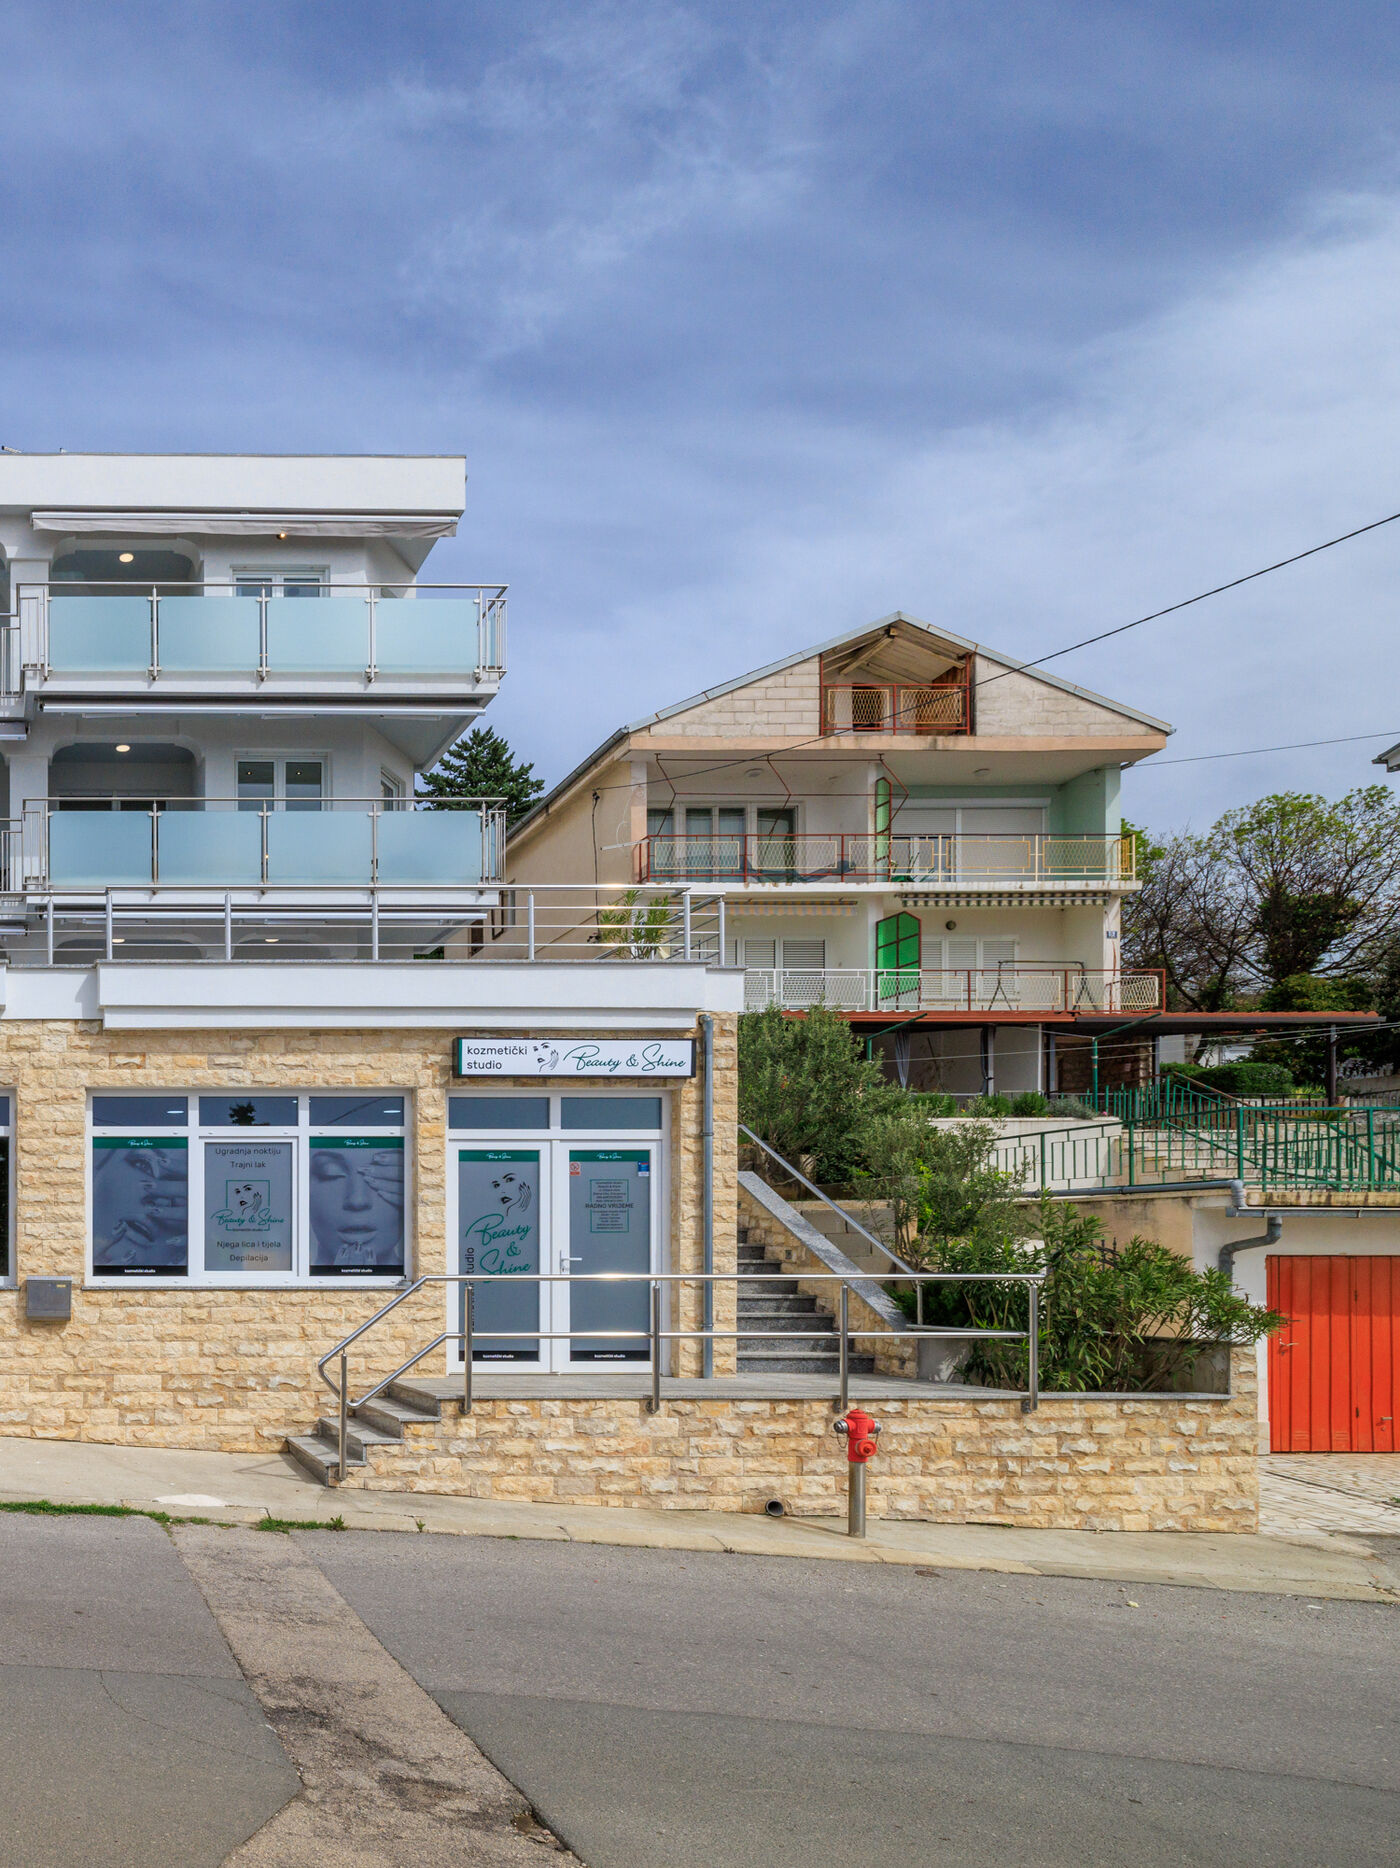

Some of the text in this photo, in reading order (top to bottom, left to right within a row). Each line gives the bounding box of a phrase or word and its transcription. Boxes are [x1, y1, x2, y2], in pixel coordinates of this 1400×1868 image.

[466, 1045, 528, 1056] kozmetički
[563, 1043, 687, 1072] Beauty & Shine
[466, 1060, 503, 1070] studio
[215, 1147, 282, 1157] Ugradnja noktiju
[230, 1160, 267, 1170] Trajni lak
[210, 1209, 246, 1227] Beauty
[257, 1207, 285, 1226] Shine
[465, 1213, 532, 1246] Beauty
[216, 1241, 240, 1249] Njega
[241, 1240, 256, 1248] lica
[261, 1240, 282, 1249] tijela
[506, 1241, 521, 1257] &
[229, 1254, 269, 1263] Depilacija
[465, 1247, 475, 1275] tudio
[479, 1248, 532, 1283] Shine
